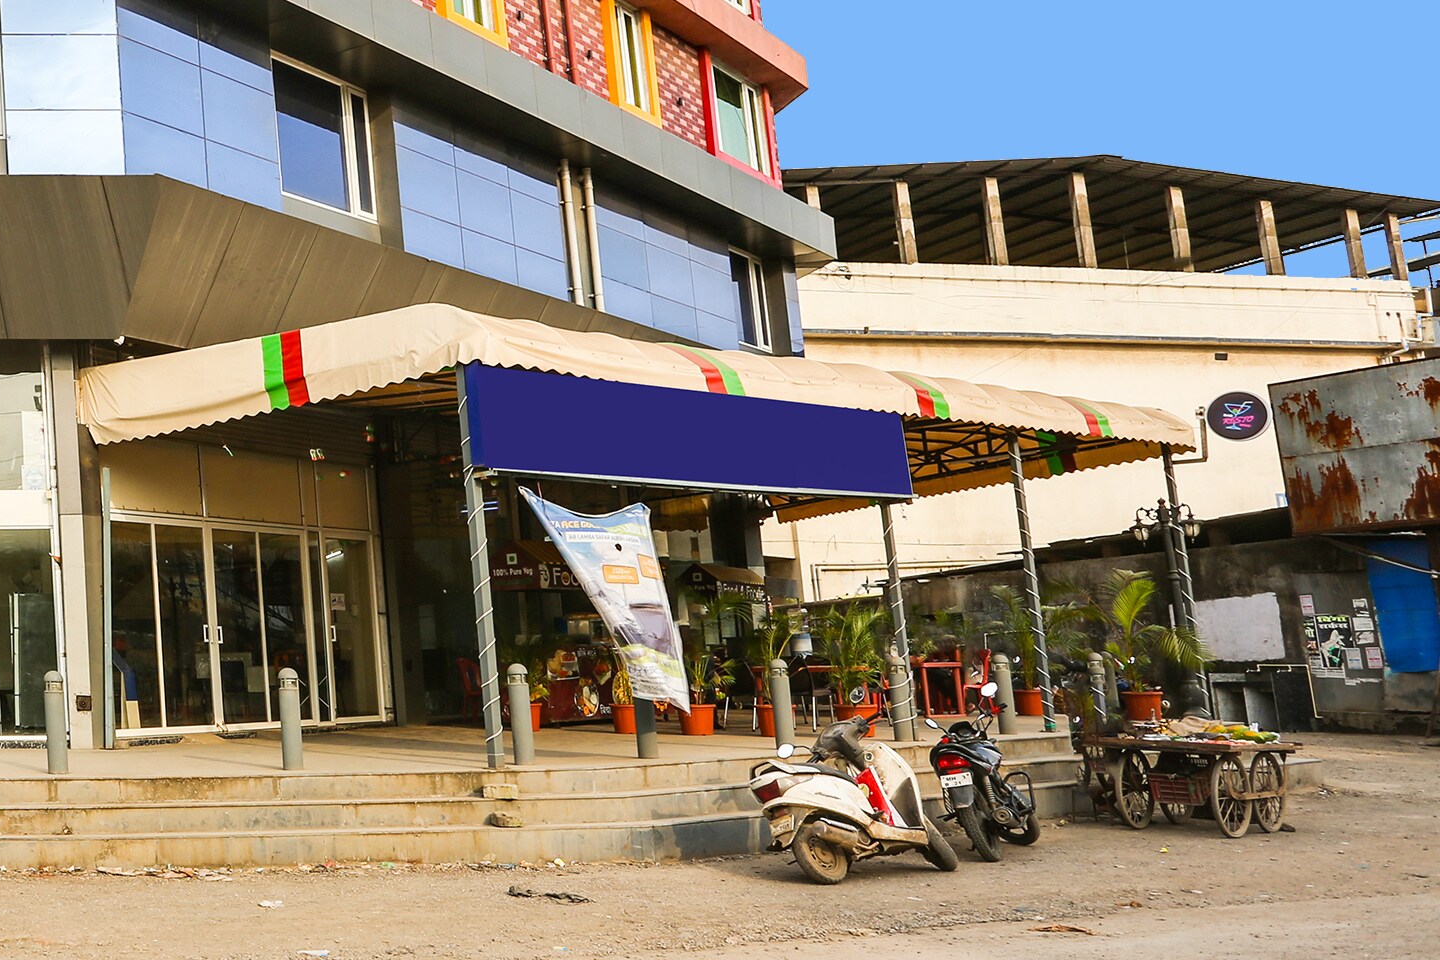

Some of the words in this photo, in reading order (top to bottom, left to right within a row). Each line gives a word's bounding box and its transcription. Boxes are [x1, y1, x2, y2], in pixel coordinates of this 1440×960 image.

[492, 568, 509, 577] 100%
[509, 568, 522, 576] Pure
[552, 567, 580, 587] Foo
